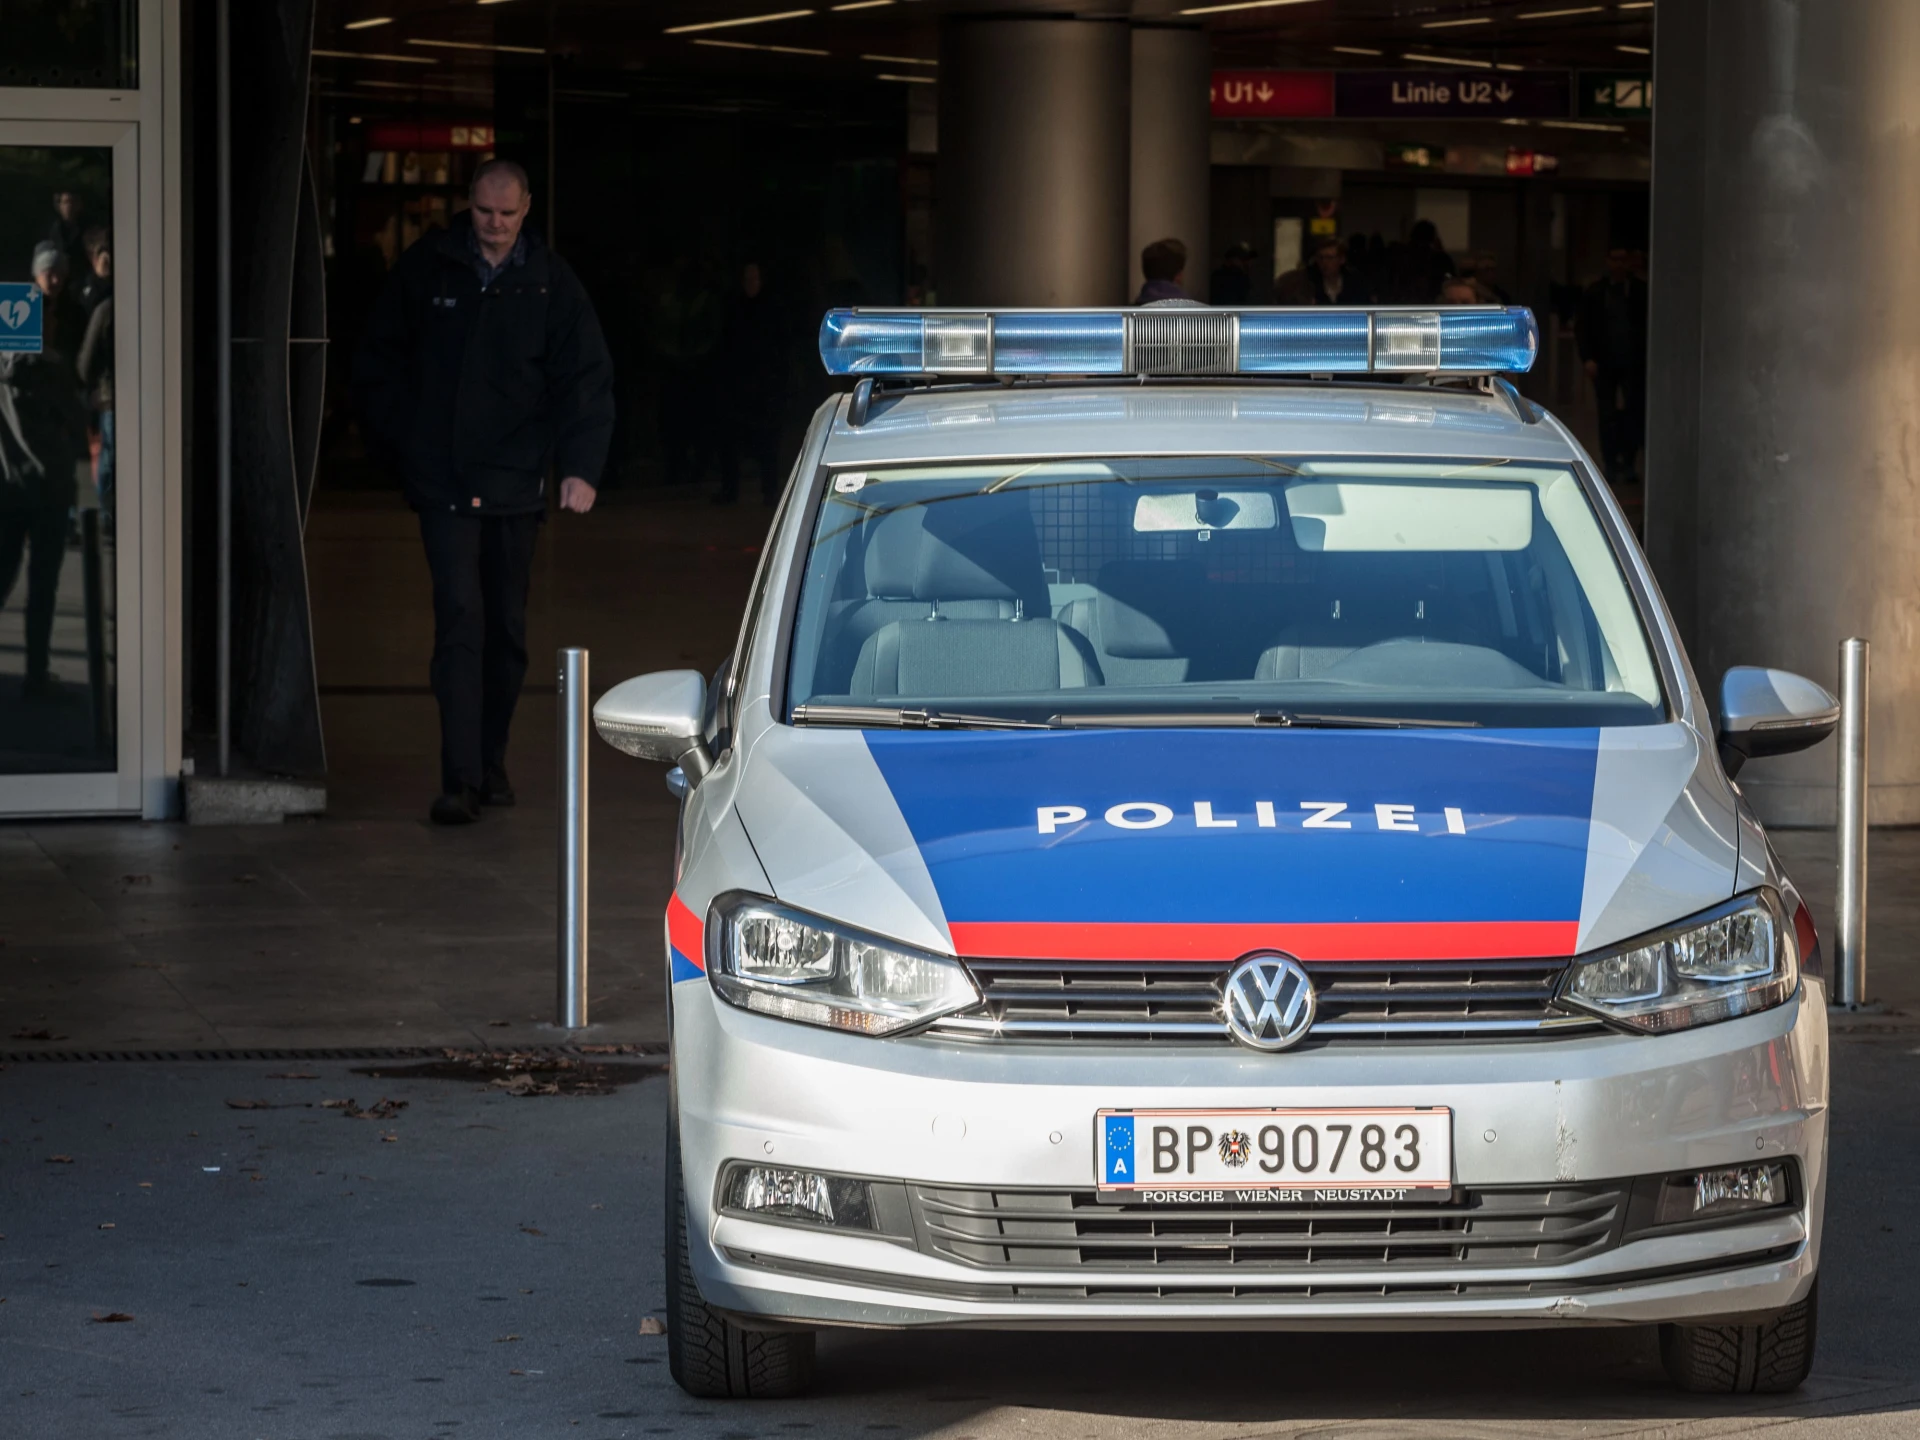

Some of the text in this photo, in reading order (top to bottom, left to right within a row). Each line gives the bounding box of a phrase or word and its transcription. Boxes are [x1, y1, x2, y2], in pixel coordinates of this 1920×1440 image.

[1224, 80, 1254, 103] U1
[1391, 81, 1493, 104] Linie U2
[1036, 801, 1467, 834] POLIZEI
[1152, 1124, 1421, 1174] BP 90783
[1113, 1157, 1127, 1174] A
[1142, 1189, 1408, 1203] PORSCHE WIENER NEUSTADT
